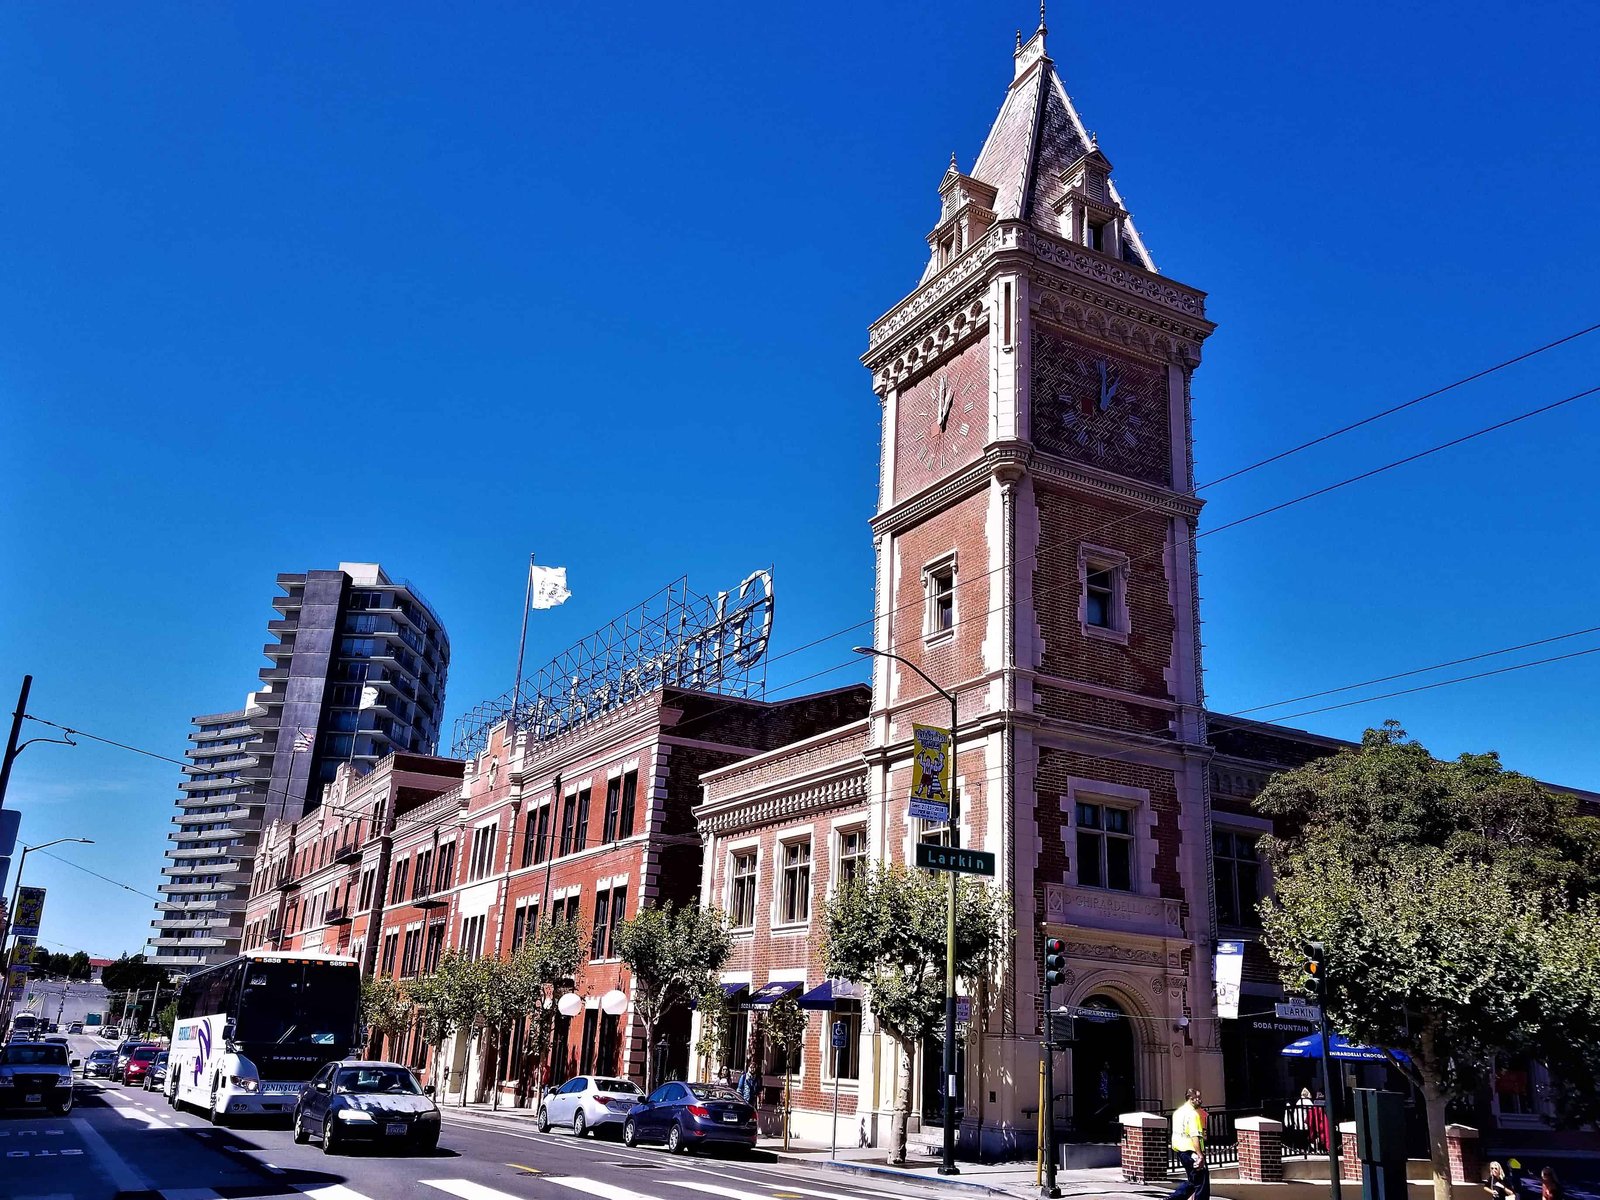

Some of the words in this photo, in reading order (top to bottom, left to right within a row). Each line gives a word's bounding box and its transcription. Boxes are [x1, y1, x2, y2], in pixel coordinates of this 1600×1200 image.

[928, 850, 984, 870] Larkin
[1283, 1006, 1314, 1018] LARKIN
[1252, 1021, 1273, 1030] SODA
[1274, 1023, 1309, 1033] FOUNTAIN
